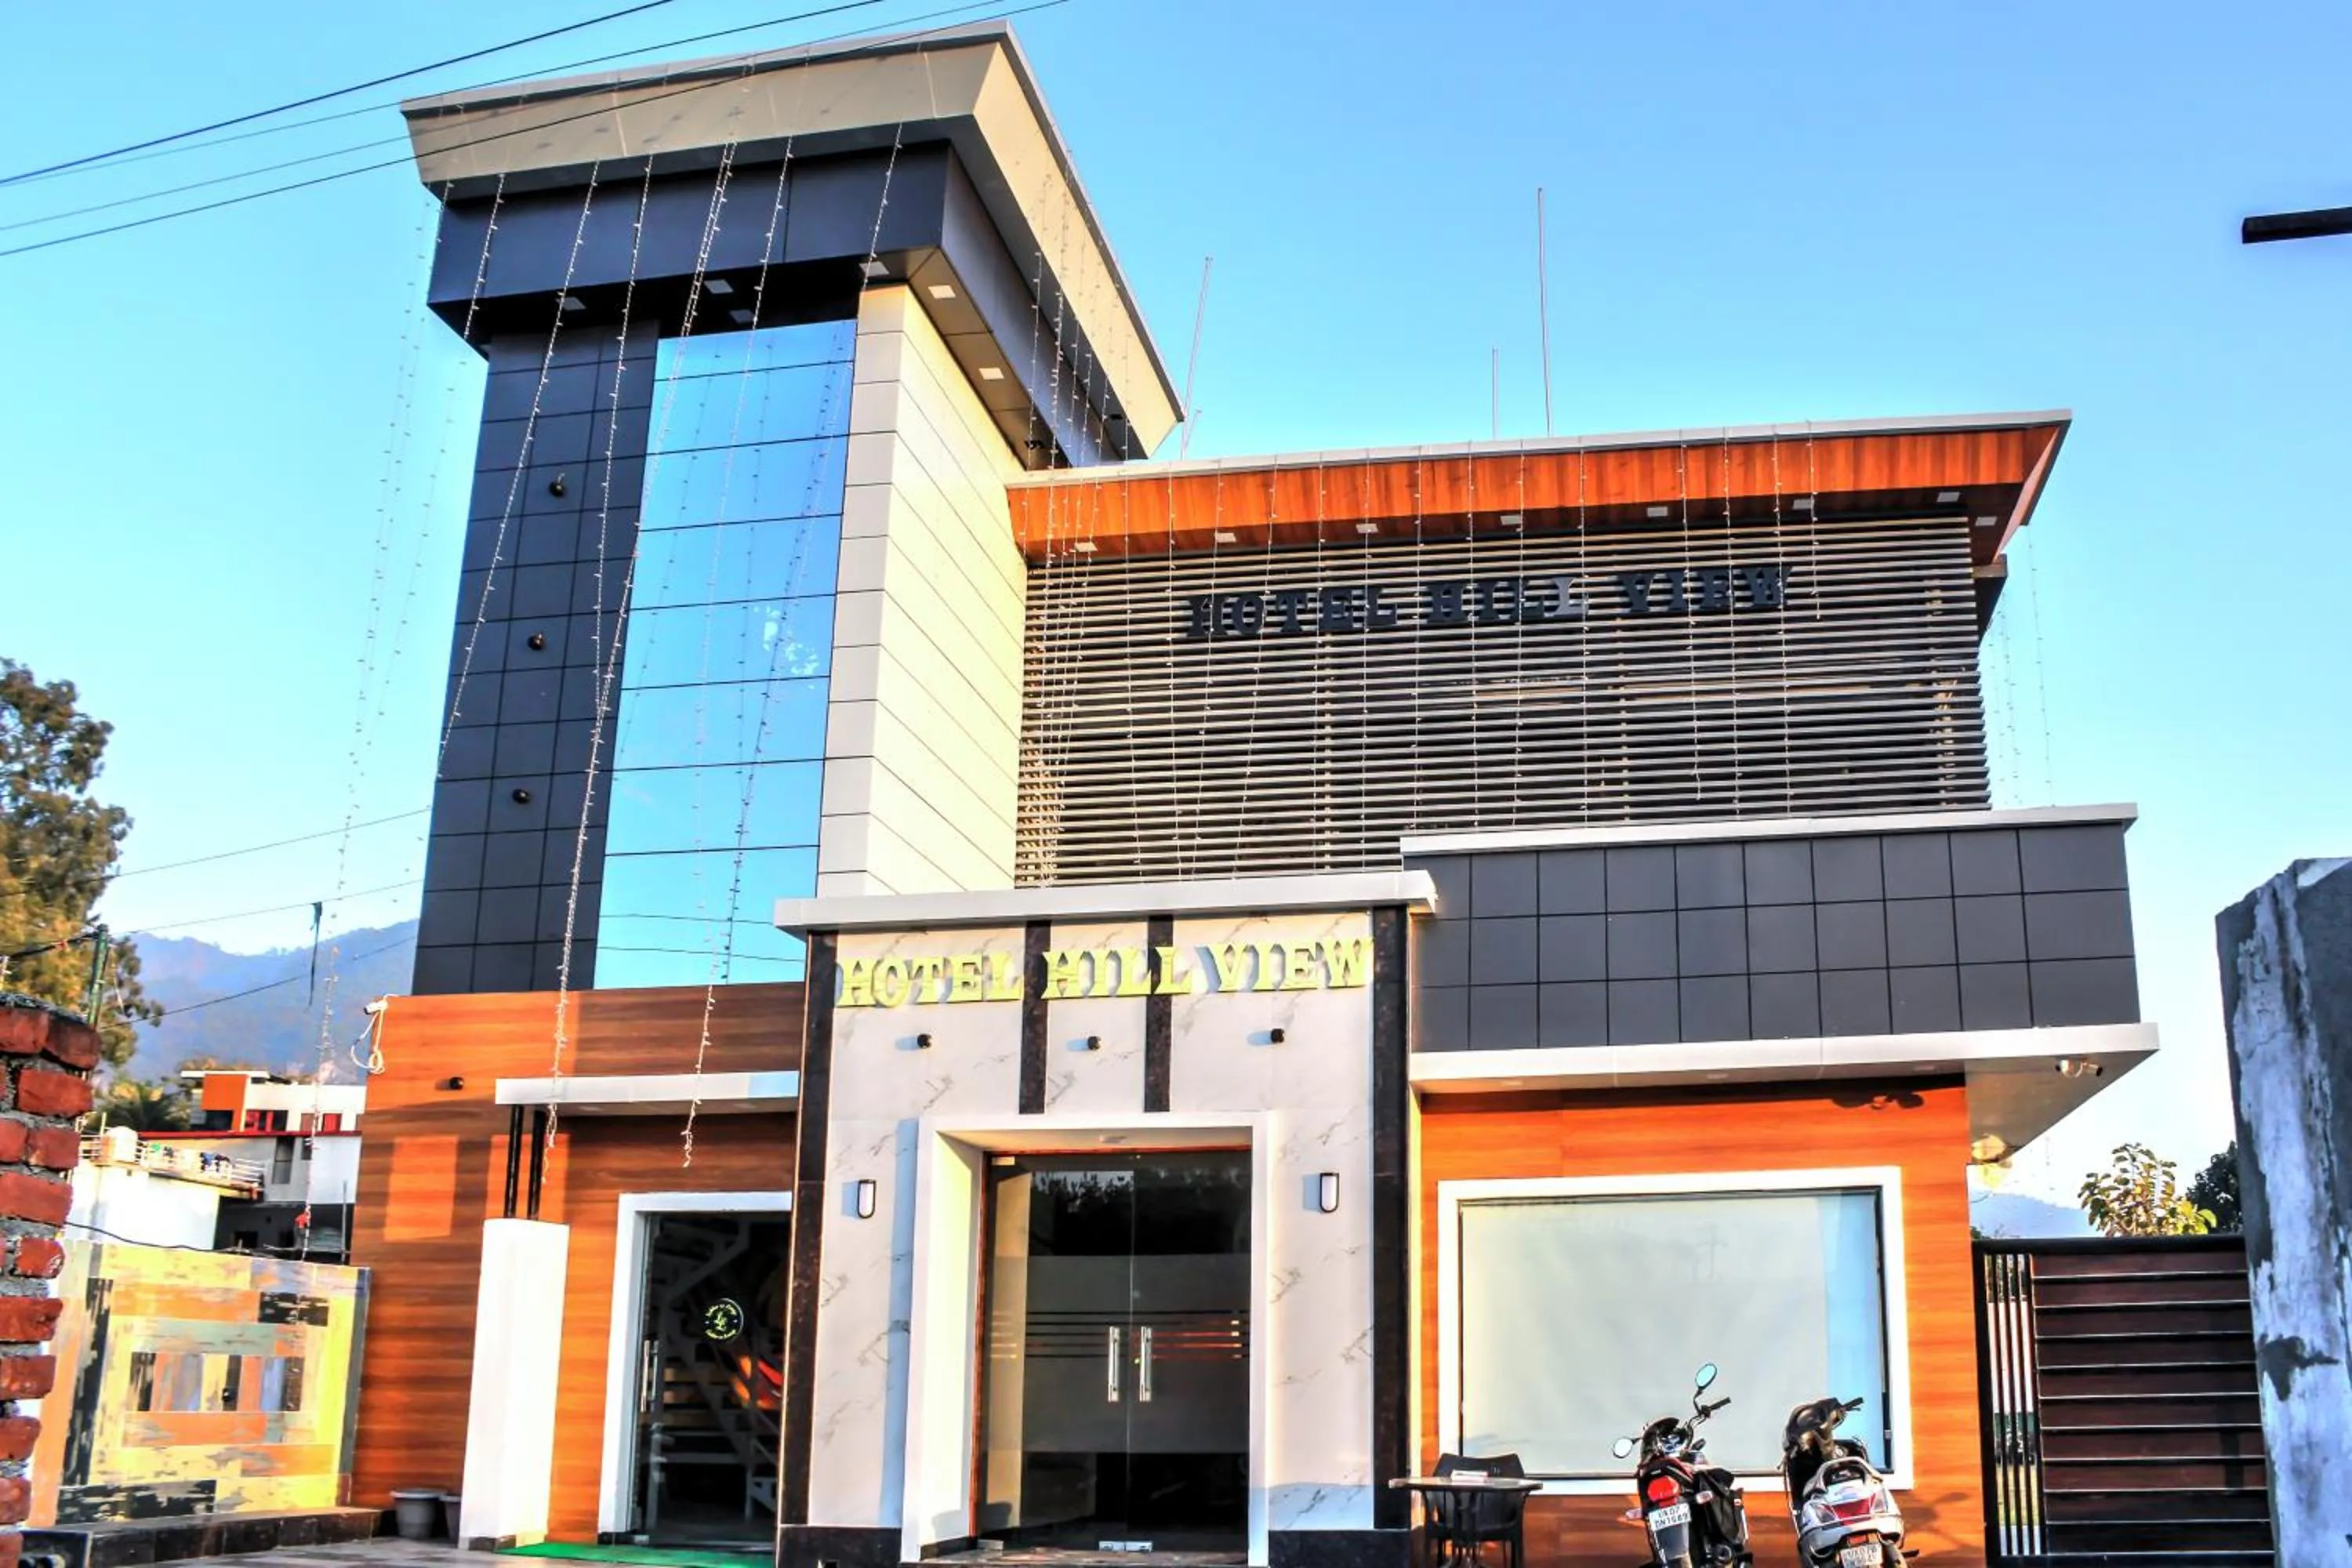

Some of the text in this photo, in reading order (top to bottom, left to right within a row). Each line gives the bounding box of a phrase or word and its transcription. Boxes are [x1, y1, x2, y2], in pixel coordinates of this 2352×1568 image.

[1185, 565, 1793, 638] HOTEL HILL VIEW
[837, 937, 1374, 1009] HOTEL HILL VIEW
